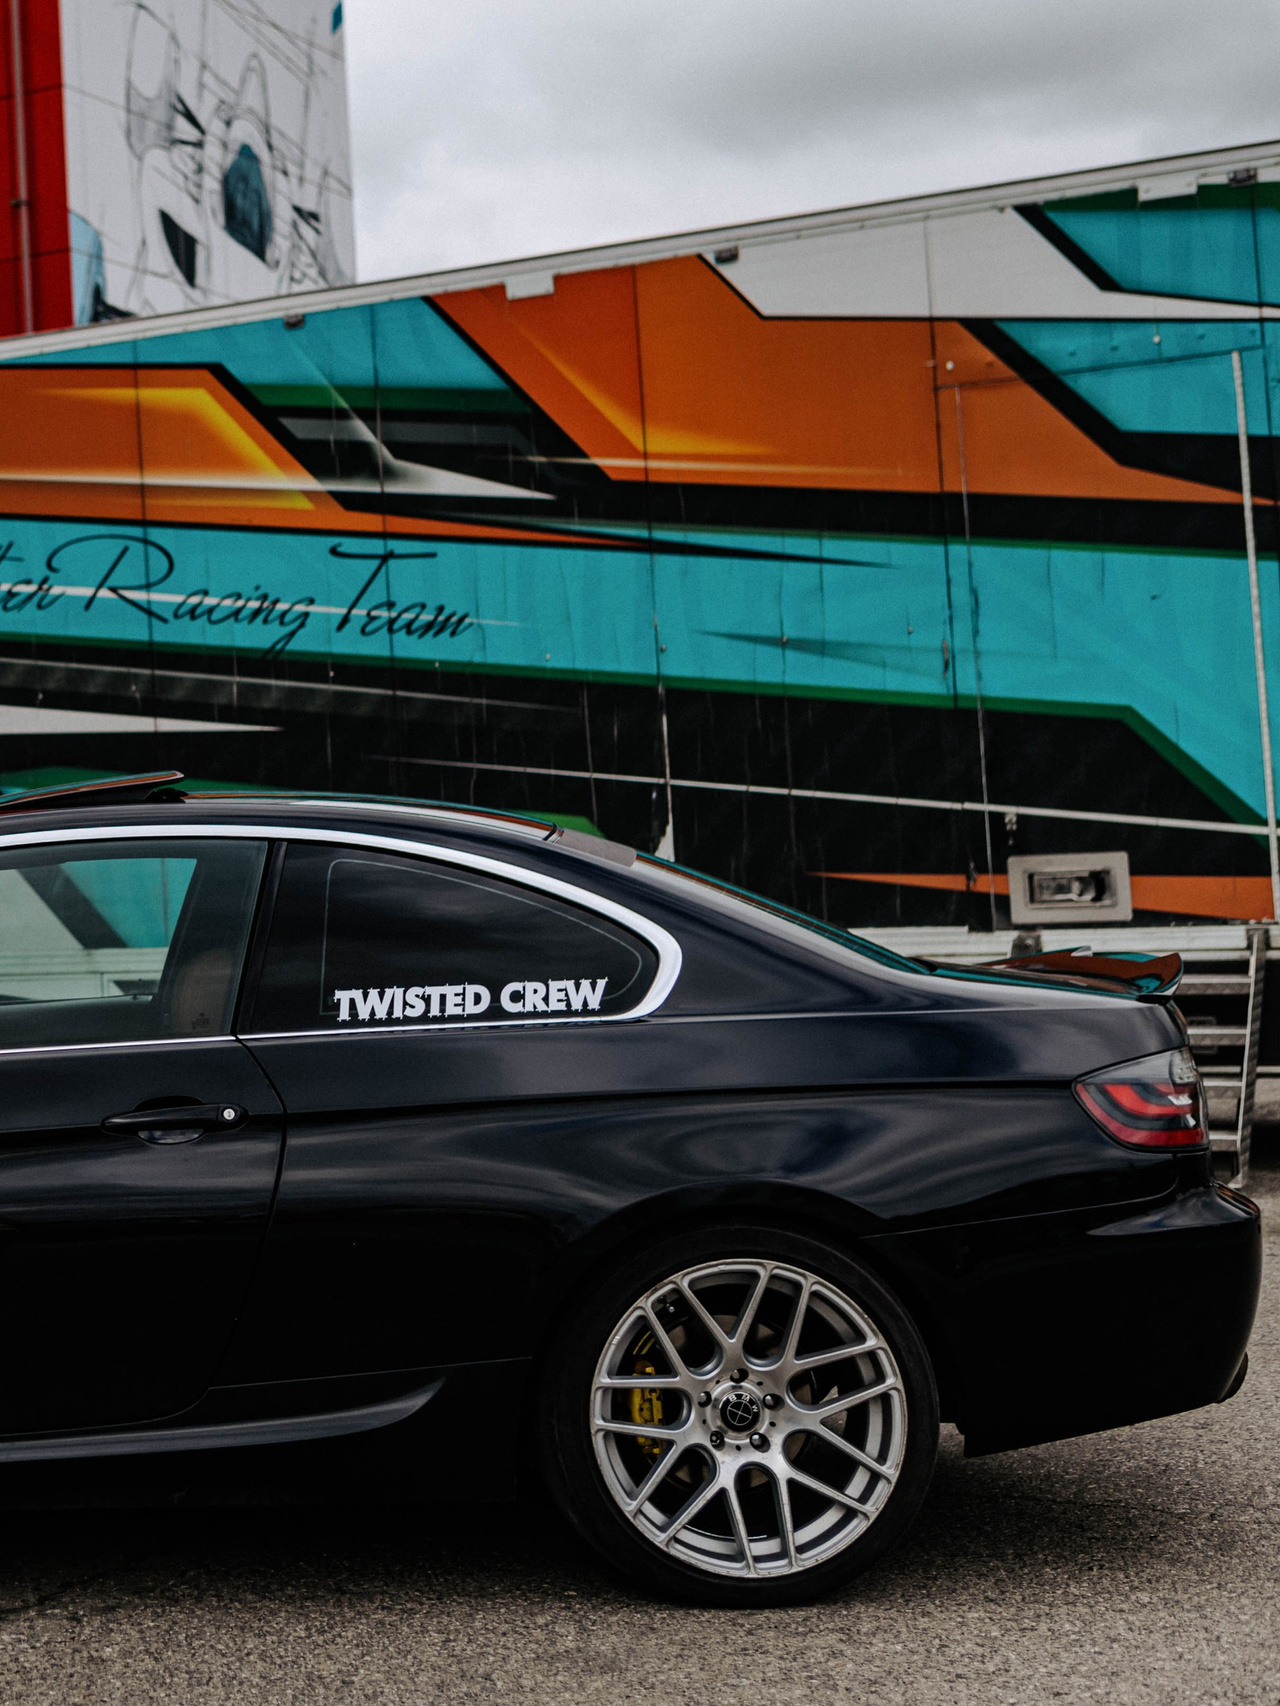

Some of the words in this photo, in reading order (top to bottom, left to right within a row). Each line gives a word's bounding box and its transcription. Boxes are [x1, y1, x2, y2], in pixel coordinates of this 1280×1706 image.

[46, 533, 315, 660] Racing
[329, 542, 474, 640] Team
[333, 981, 491, 1022] TWISTED
[500, 976, 609, 1014] CREW
[728, 1393, 759, 1412] BMW
